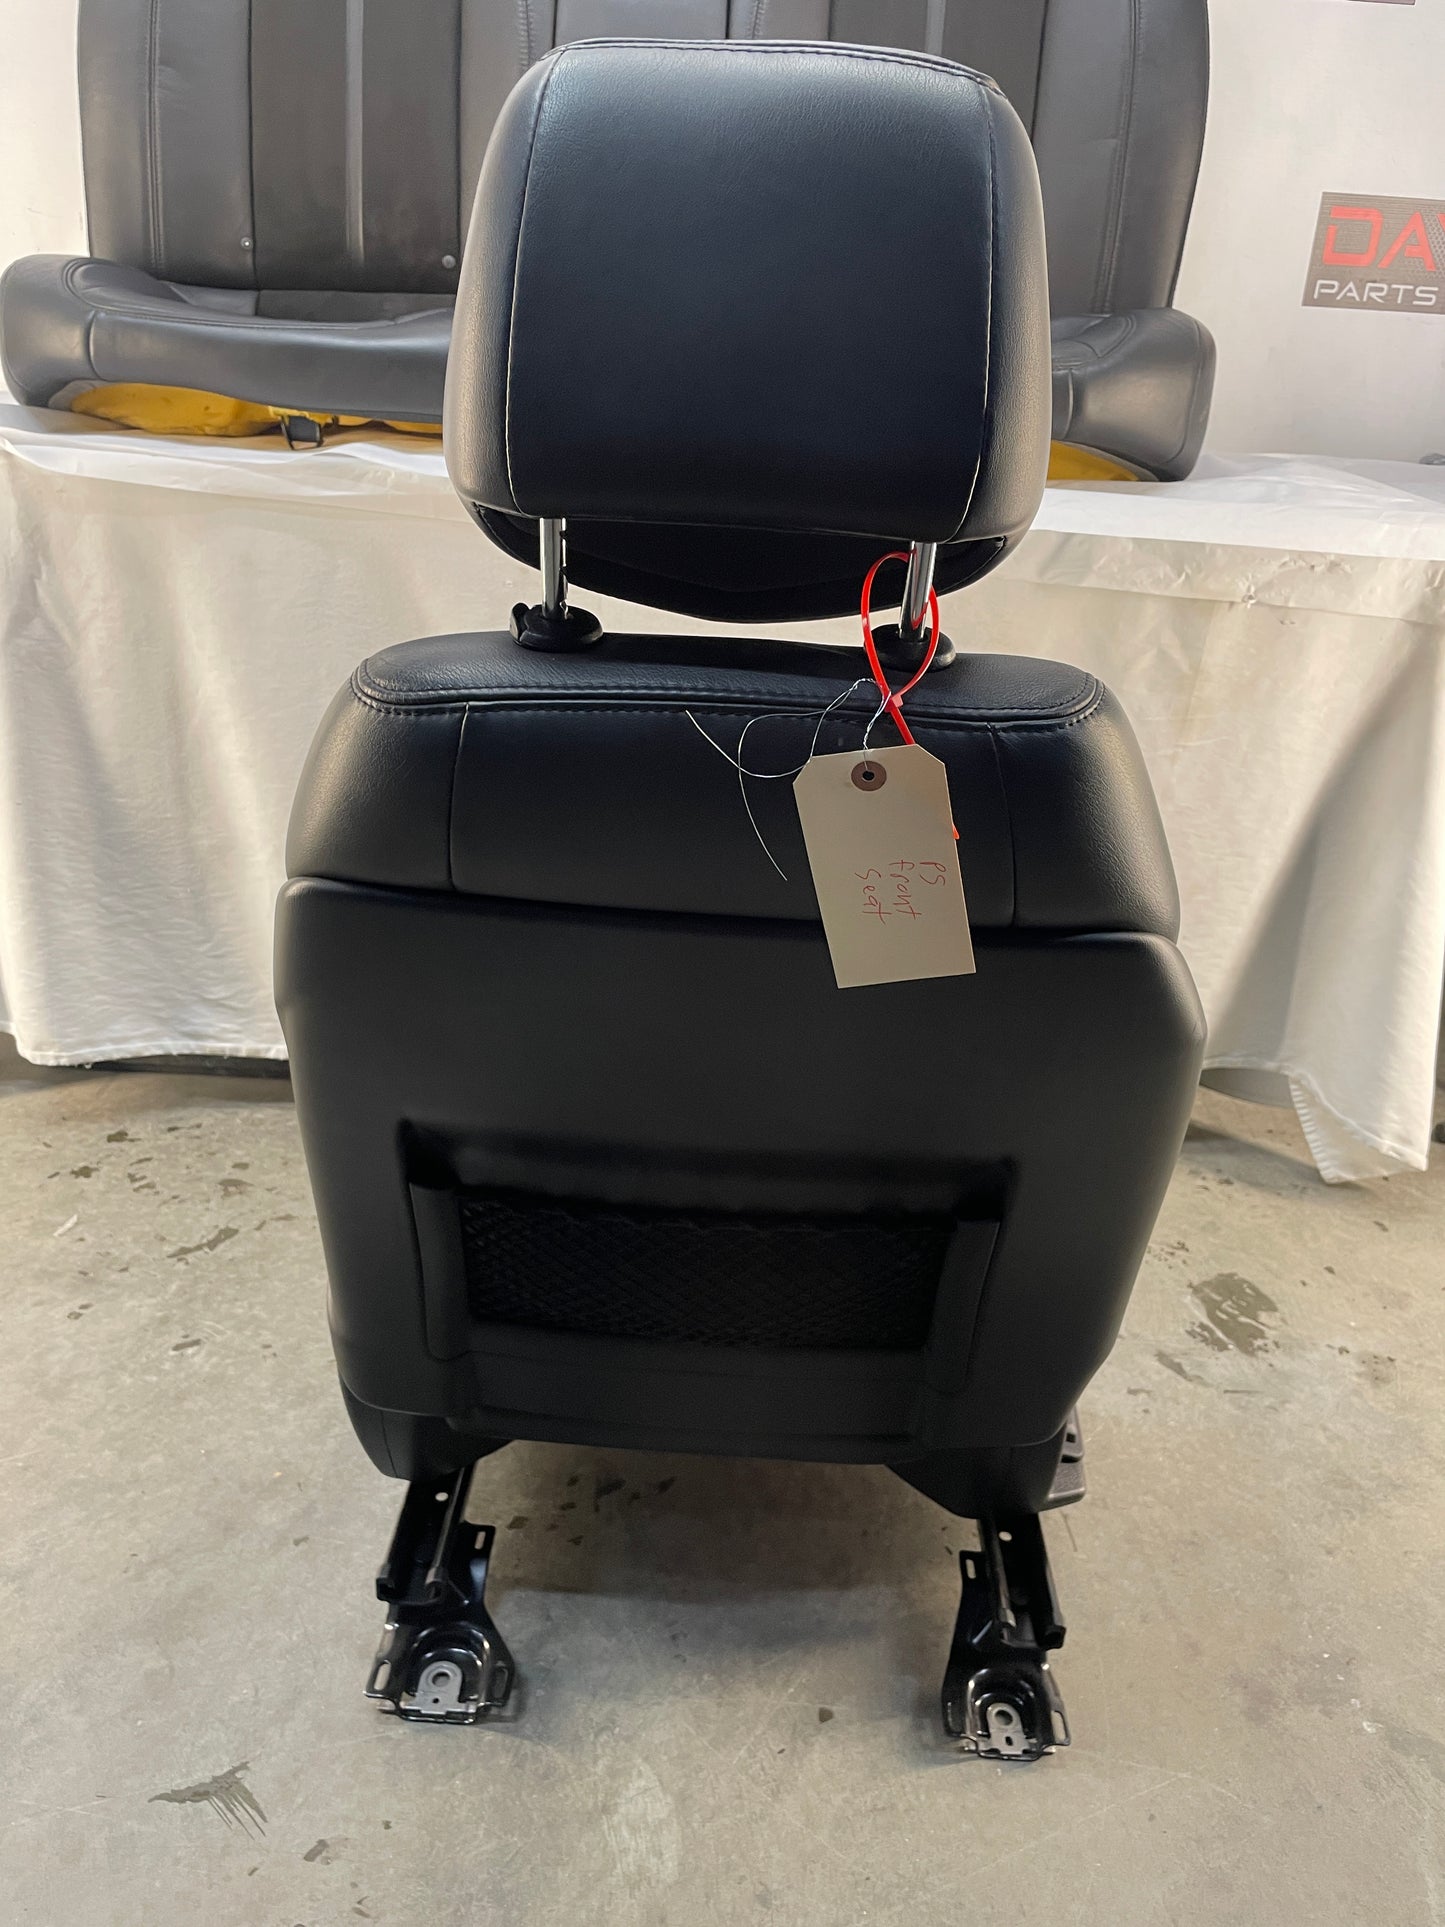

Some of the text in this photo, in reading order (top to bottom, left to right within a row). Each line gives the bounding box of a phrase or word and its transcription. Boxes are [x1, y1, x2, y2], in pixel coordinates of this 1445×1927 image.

[1323, 205, 1445, 271] DA
[1313, 279, 1439, 306] PARTS
[920, 861, 947, 886] PS
